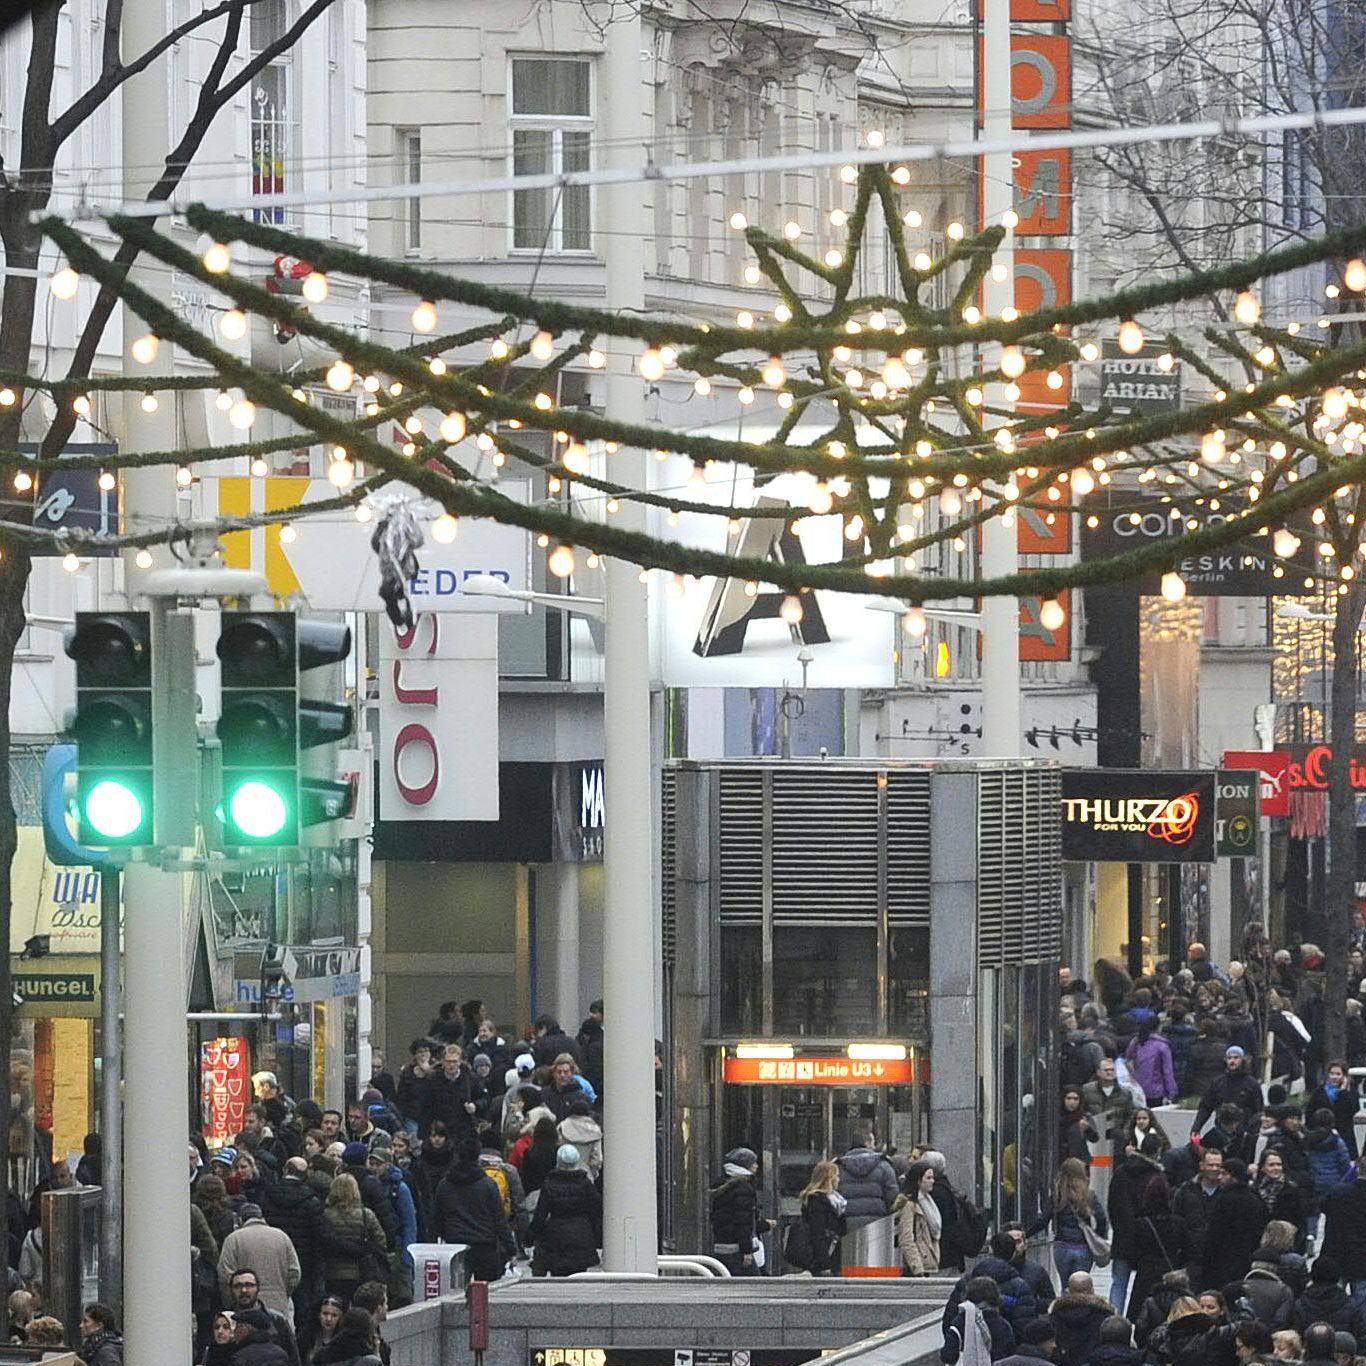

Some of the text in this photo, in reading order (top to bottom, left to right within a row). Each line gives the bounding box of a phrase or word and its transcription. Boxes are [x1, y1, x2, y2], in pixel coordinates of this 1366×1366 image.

[1103, 359, 1178, 375] HOTE
[1062, 798, 1192, 824] THURZO
[1094, 823, 1146, 832] FOR YOU
[814, 1061, 871, 1077] Linie U3
